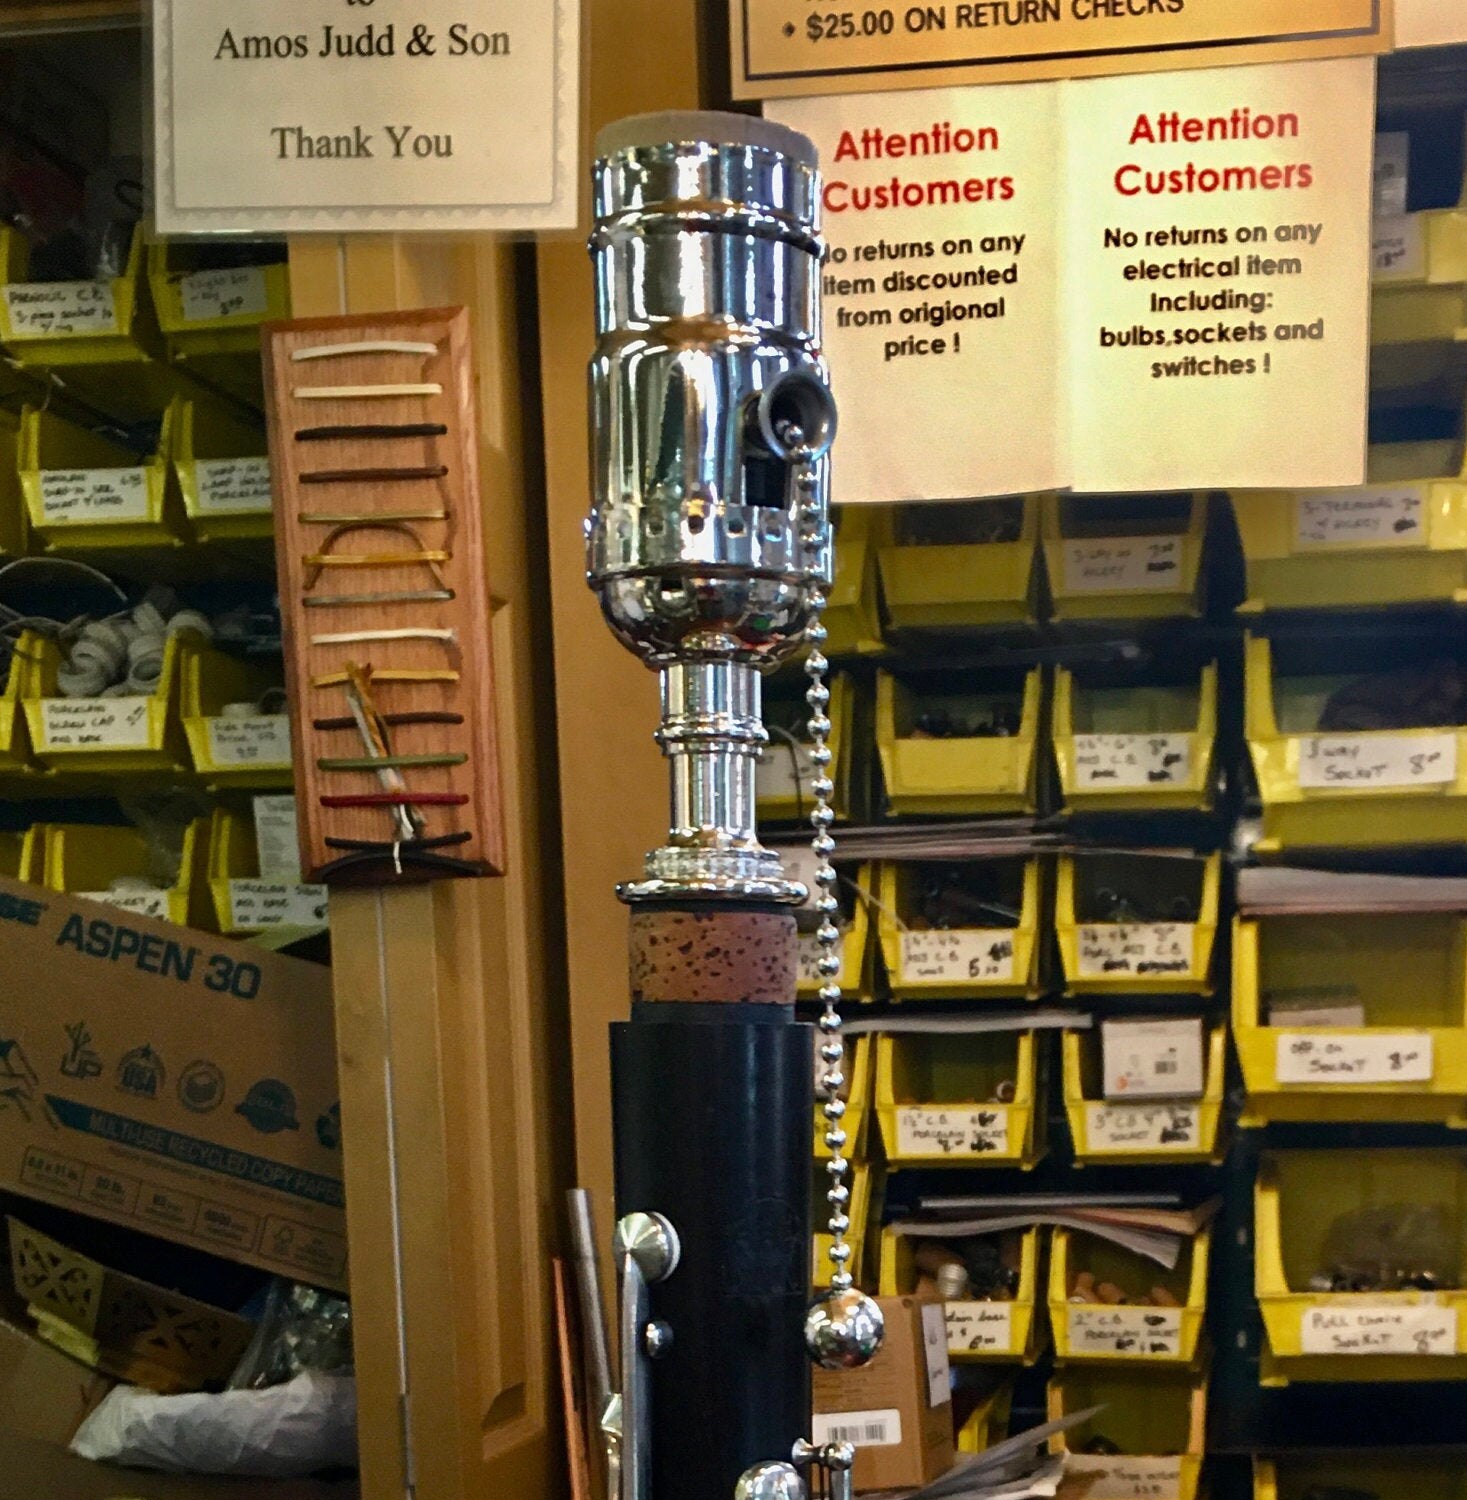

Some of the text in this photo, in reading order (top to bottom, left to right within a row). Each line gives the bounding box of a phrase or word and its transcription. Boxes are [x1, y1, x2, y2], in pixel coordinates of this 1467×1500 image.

[806, 0, 1184, 42] $25.00 ON RETURN CHECKS
[214, 23, 511, 60] Amos Judd & Son
[271, 125, 453, 159] Thank You
[833, 122, 999, 162] Attention
[1128, 107, 1299, 144] Attention
[822, 176, 1015, 213] Customers
[1114, 162, 1313, 196] Customers
[853, 239, 935, 262] returns
[942, 239, 973, 256] on
[980, 234, 1026, 255] any
[1104, 223, 1323, 248] No returns on any
[823, 263, 1018, 296] item discounted
[1123, 254, 1302, 280] electrical item
[837, 297, 1005, 328] from origional
[1150, 289, 1273, 314] Including:
[1274, 318, 1324, 340] and
[884, 332, 961, 361] price !
[1151, 352, 1271, 378] switches !
[56, 913, 196, 983] ASPEN
[203, 953, 263, 1000] 30
